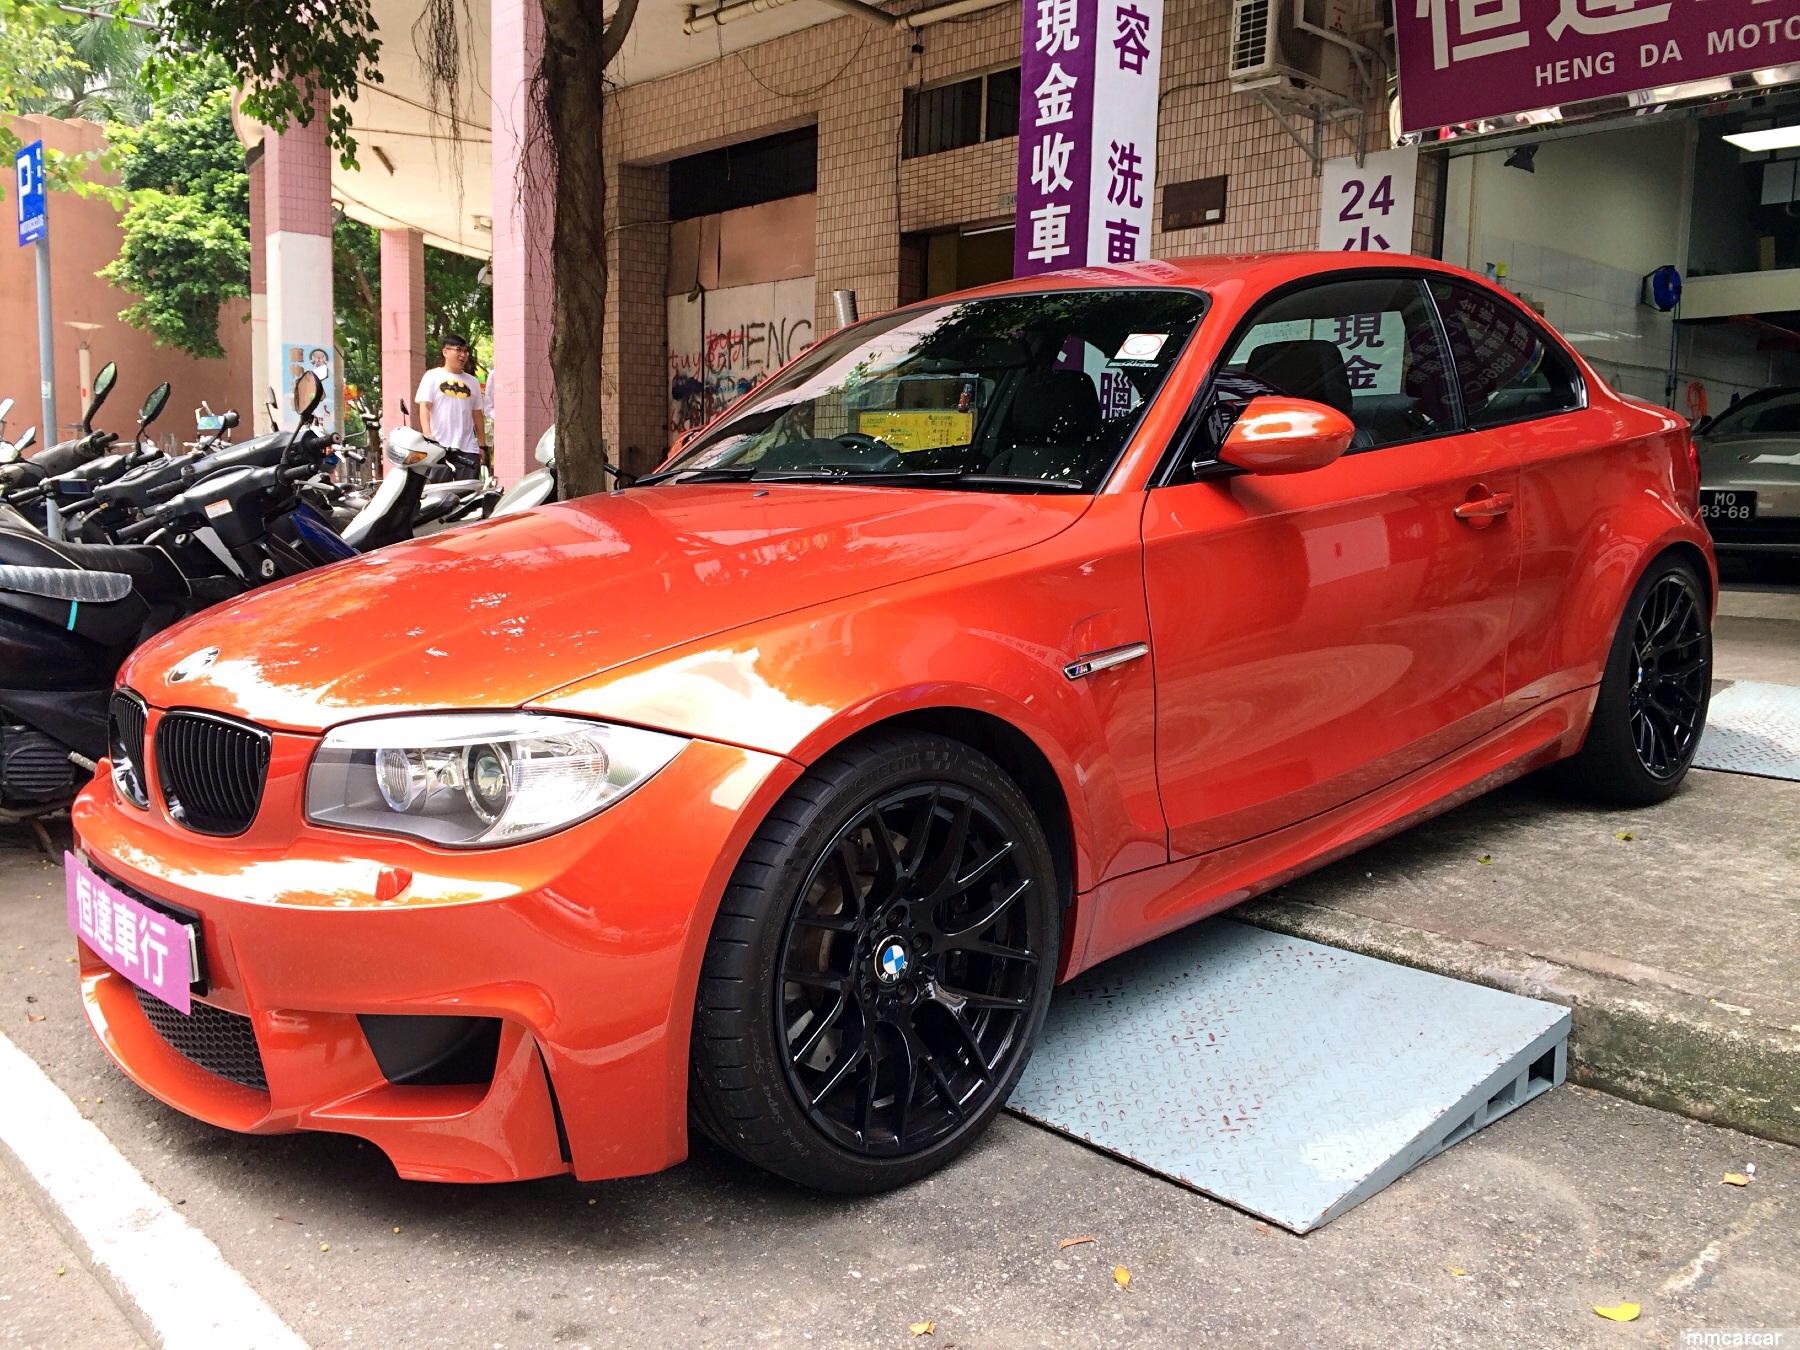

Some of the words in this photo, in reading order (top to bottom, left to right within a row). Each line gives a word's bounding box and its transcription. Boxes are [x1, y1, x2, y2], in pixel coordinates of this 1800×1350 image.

[1535, 51, 1616, 87] HENG
[1639, 39, 1683, 68] DA
[1028, 0, 1080, 264] 現金收車
[17, 154, 31, 221] P
[1339, 174, 1395, 221] 24
[1714, 492, 1736, 506] MO
[76, 870, 168, 987] 恒達車行
